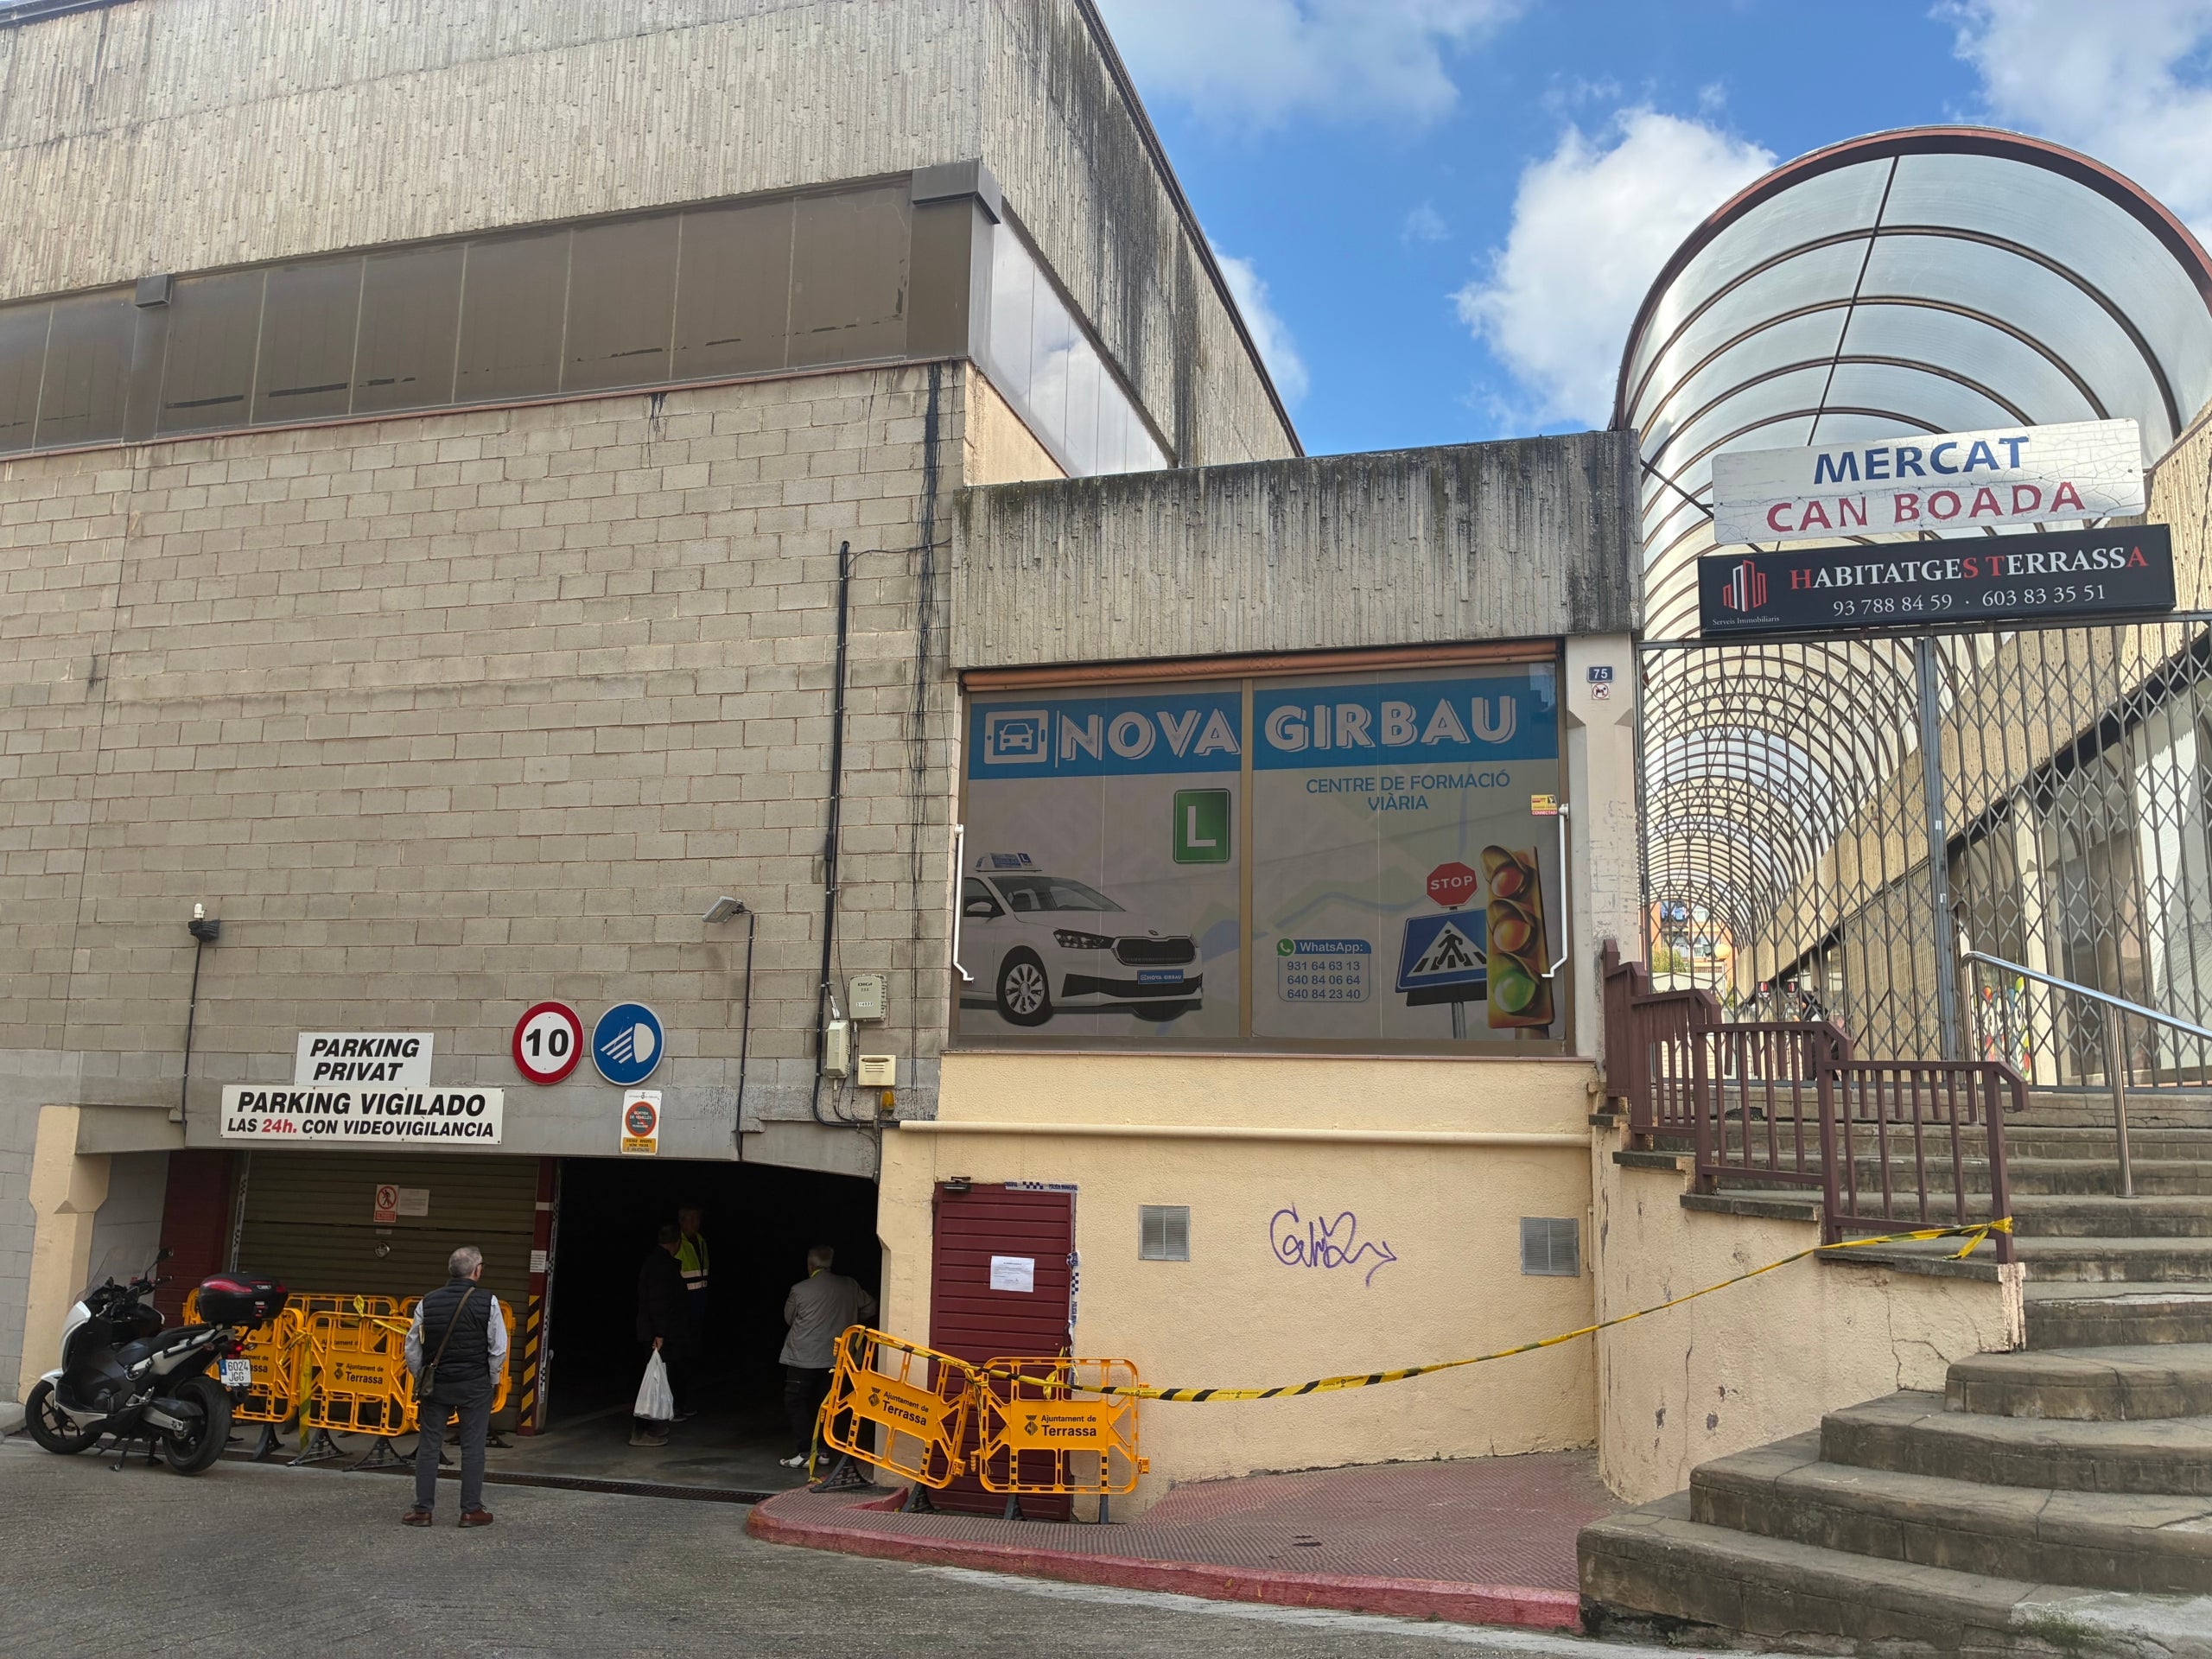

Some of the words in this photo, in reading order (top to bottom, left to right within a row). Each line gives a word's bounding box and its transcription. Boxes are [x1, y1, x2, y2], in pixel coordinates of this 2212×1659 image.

[1815, 436, 2029, 485] MERCAT
[1766, 496, 1867, 533] CAN
[1894, 482, 2086, 524] BOADA
[1790, 557, 1979, 589] HABITATGES
[1985, 546, 2149, 576] TERRASSA
[1833, 601, 1855, 616] 93
[1861, 598, 1895, 614] 788
[1902, 594, 1923, 611] 84
[1930, 594, 1952, 611] 59
[1982, 590, 2017, 607] 603
[2024, 588, 2046, 604] 83
[2053, 586, 2076, 603] 35
[2084, 584, 2105, 601] 51
[1738, 615, 1780, 624] Immobiliaris
[1593, 669, 1608, 679] 75
[1061, 708, 1241, 761] NOVA
[1264, 696, 1517, 753] GIRBAU
[1306, 777, 1375, 793] CENTRE
[1381, 776, 1404, 791] DE
[1410, 769, 1510, 790] FORMACIÓ
[1368, 792, 1428, 811] VIÀRIA
[1187, 805, 1217, 847] L
[1430, 875, 1473, 890] STOP
[1300, 942, 1363, 954] WhatsApp:
[1287, 961, 1307, 970] 931
[1312, 961, 1325, 970] 64
[1328, 961, 1343, 970] 63
[1346, 961, 1360, 970] 13
[1287, 975, 1308, 985] 640
[1312, 975, 1325, 985] 84
[1328, 975, 1343, 985] 06
[1346, 975, 1361, 985] 64
[1287, 989, 1308, 999] 640
[1312, 989, 1325, 999] 84
[1328, 989, 1343, 999] 23
[1346, 989, 1361, 999] 40
[309, 1039, 420, 1058] PARKING
[525, 1028, 569, 1057] 10
[312, 1062, 404, 1082] PRIVAT
[237, 1091, 351, 1115] PARKING
[360, 1093, 486, 1116] VIGILADO
[227, 1118, 257, 1133] LAS
[261, 1118, 297, 1134] 24h.
[302, 1119, 338, 1135] CON
[343, 1120, 494, 1137] VIDEOVIGILANCIA
[227, 1362, 249, 1371] 6024
[346, 1363, 376, 1371] Ajuntament
[229, 1371, 245, 1382] JGG
[346, 1371, 384, 1384] Terrassa
[883, 1391, 919, 1409] Ajuntament
[883, 1400, 927, 1426] Terrassa
[1041, 1414, 1084, 1423] Ajuntament
[1041, 1424, 1097, 1437] Terrassa
